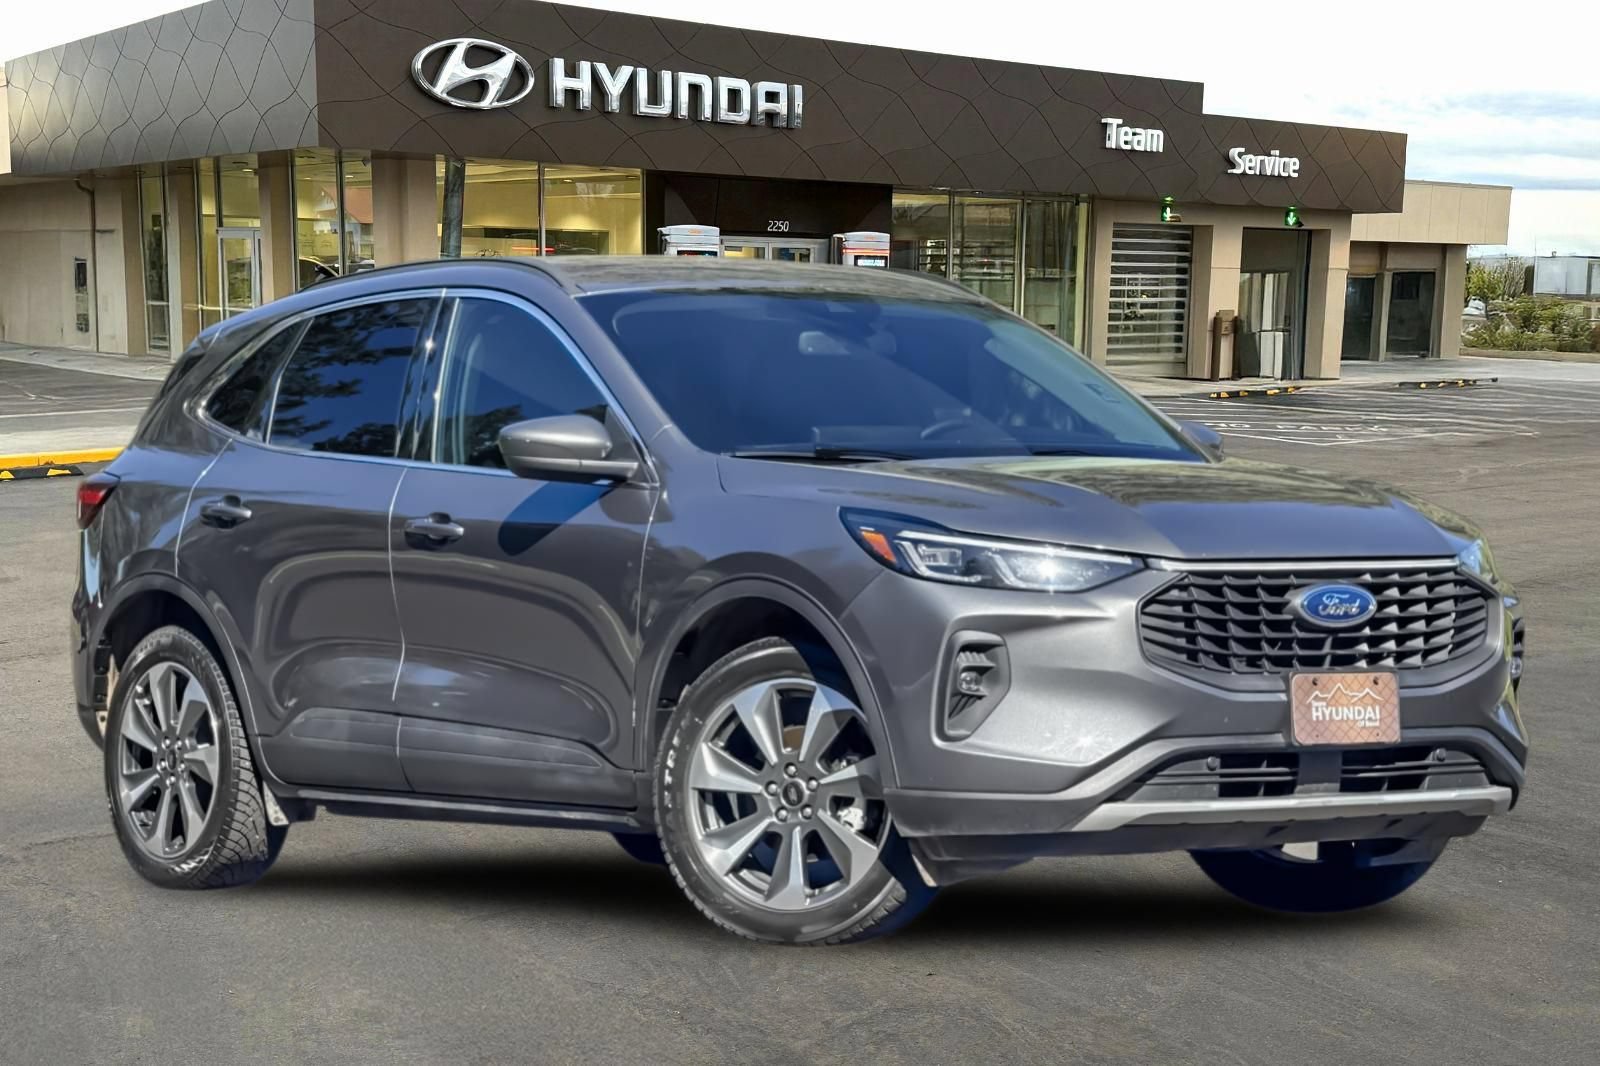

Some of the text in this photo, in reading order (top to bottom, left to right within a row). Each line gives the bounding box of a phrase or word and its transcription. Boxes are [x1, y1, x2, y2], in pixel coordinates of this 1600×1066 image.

[549, 57, 803, 129] HYUNDAI
[1102, 117, 1164, 152] Team
[1227, 147, 1300, 178] Service
[767, 220, 790, 232] 2250
[1318, 592, 1361, 616] Ford
[1311, 704, 1380, 721] HYUNDAI
